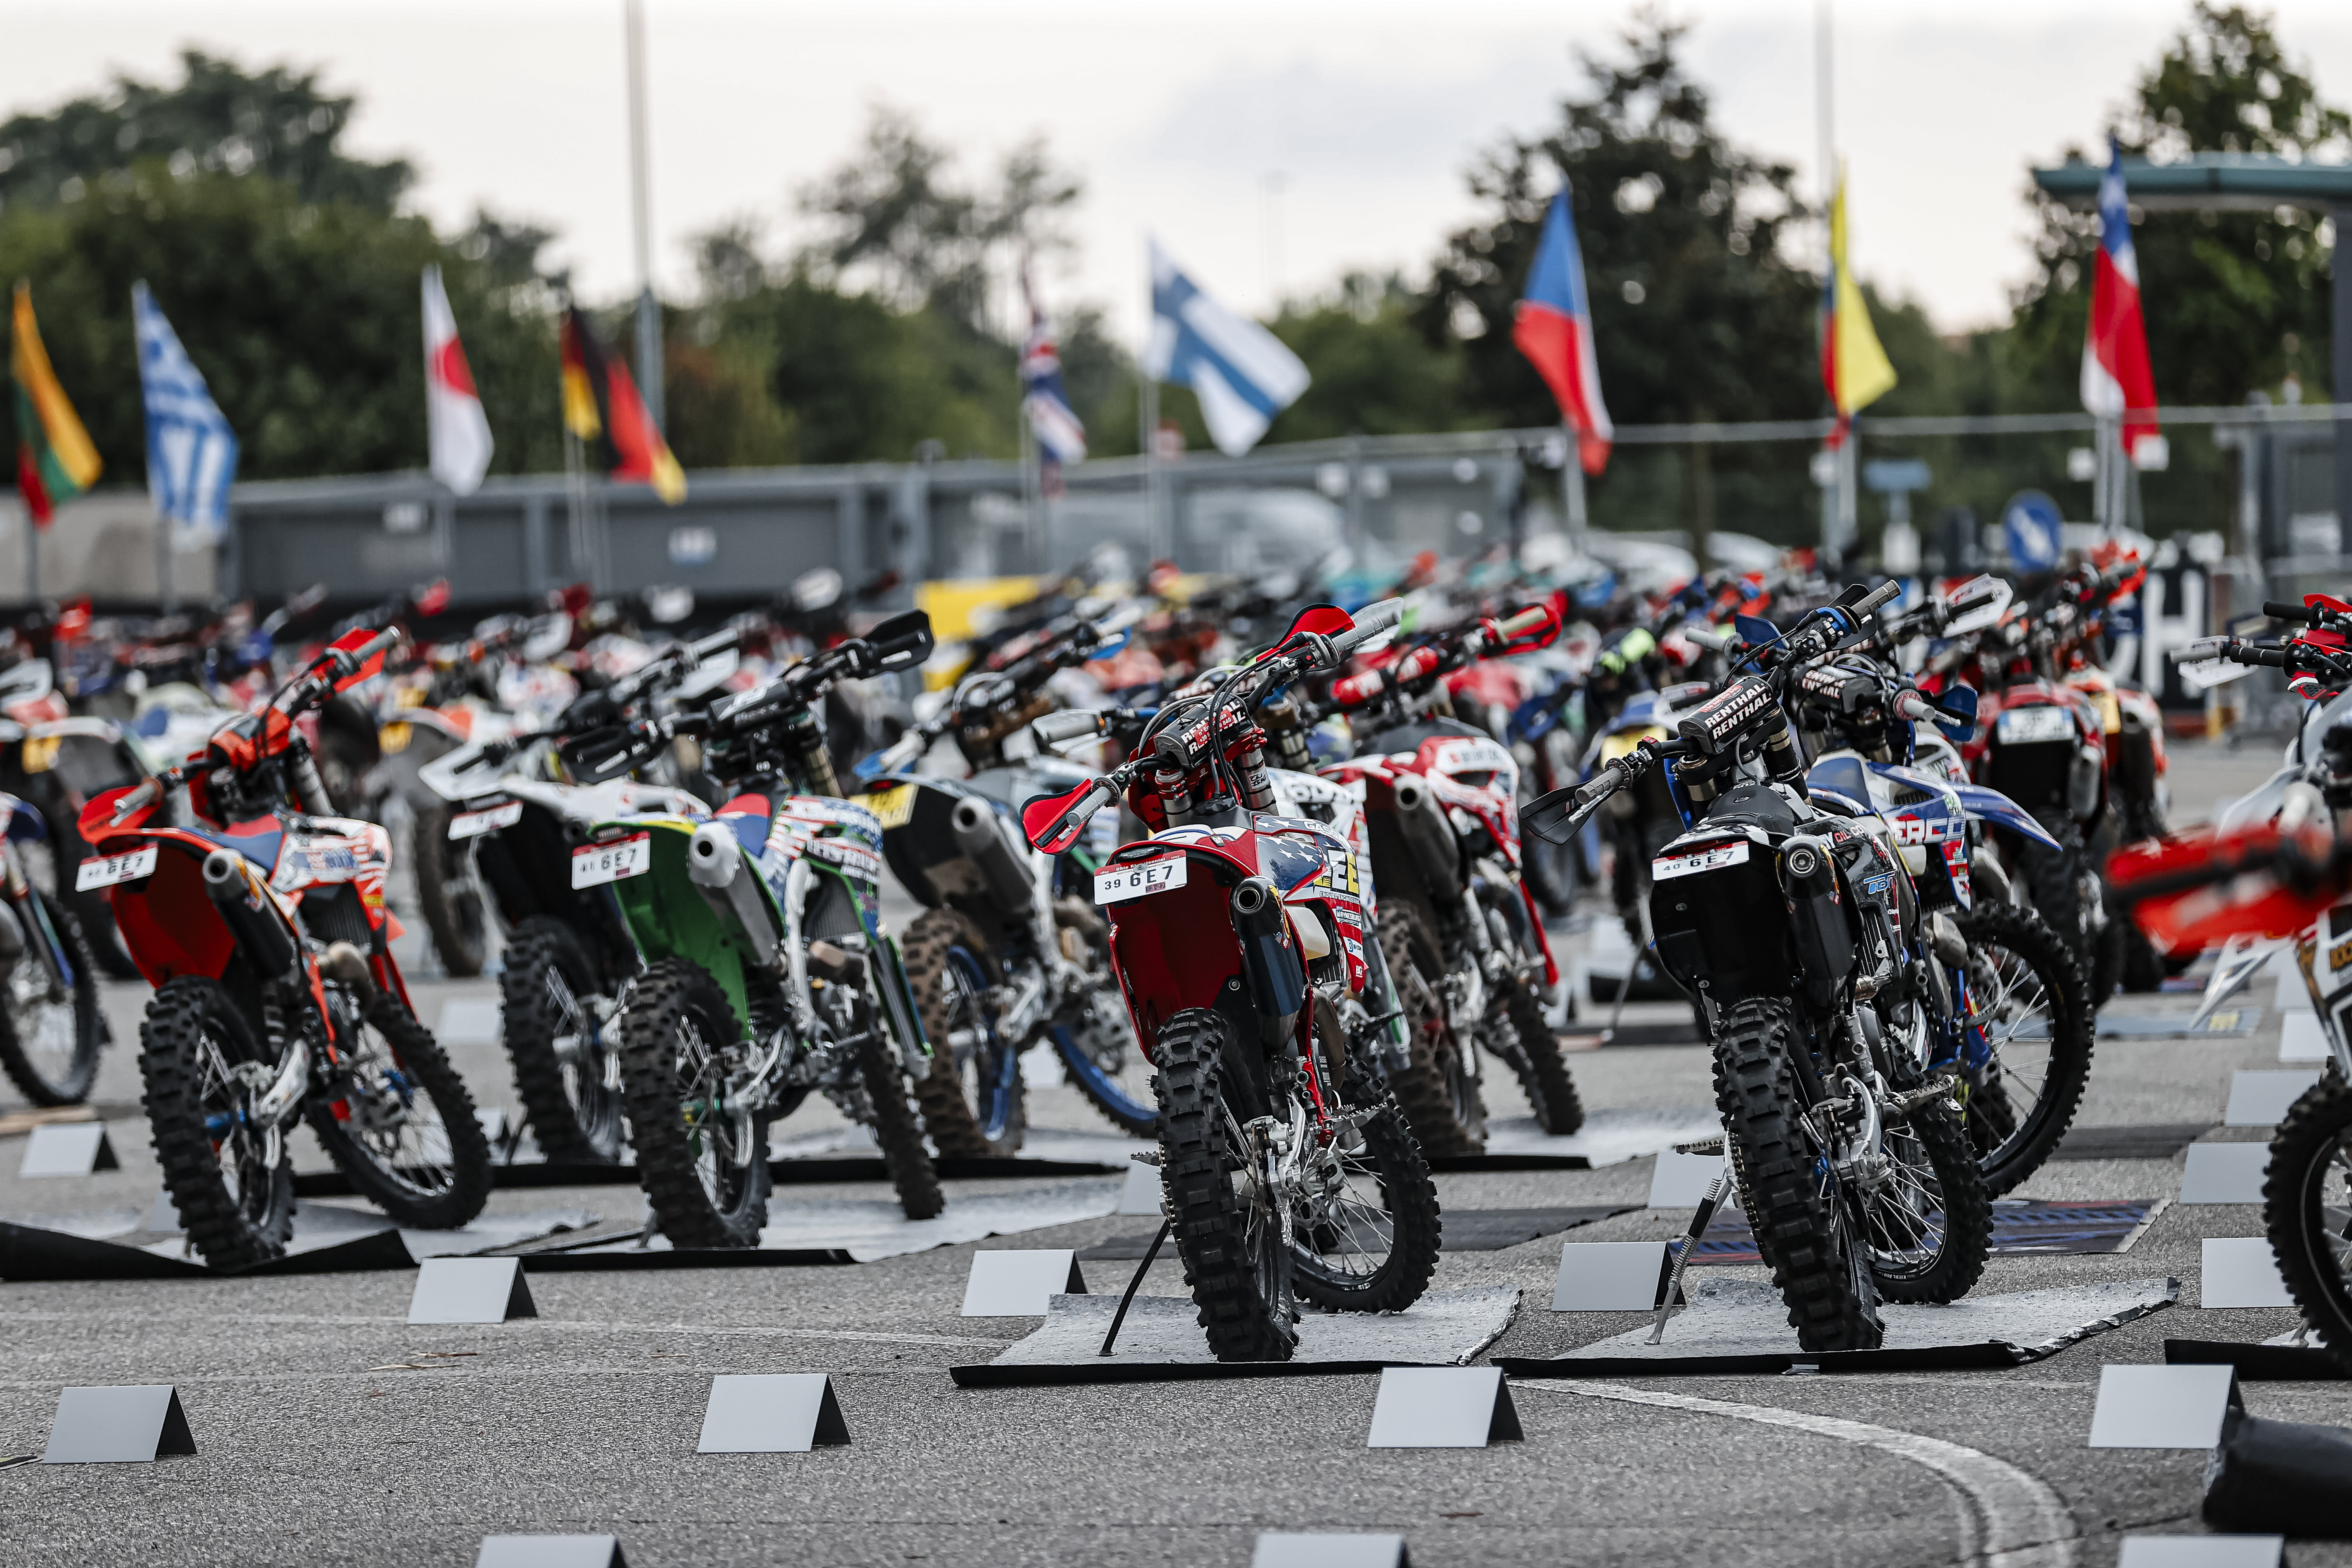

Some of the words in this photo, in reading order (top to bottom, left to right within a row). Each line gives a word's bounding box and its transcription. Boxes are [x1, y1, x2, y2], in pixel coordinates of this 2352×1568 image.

[1704, 684, 1766, 728] RENTHAL
[1223, 717, 1232, 725] 840
[1712, 693, 1772, 740] RENTHAL
[1834, 830, 1852, 843] OIL
[1130, 857, 1166, 869] Bitennial
[1105, 879, 1120, 890] 39
